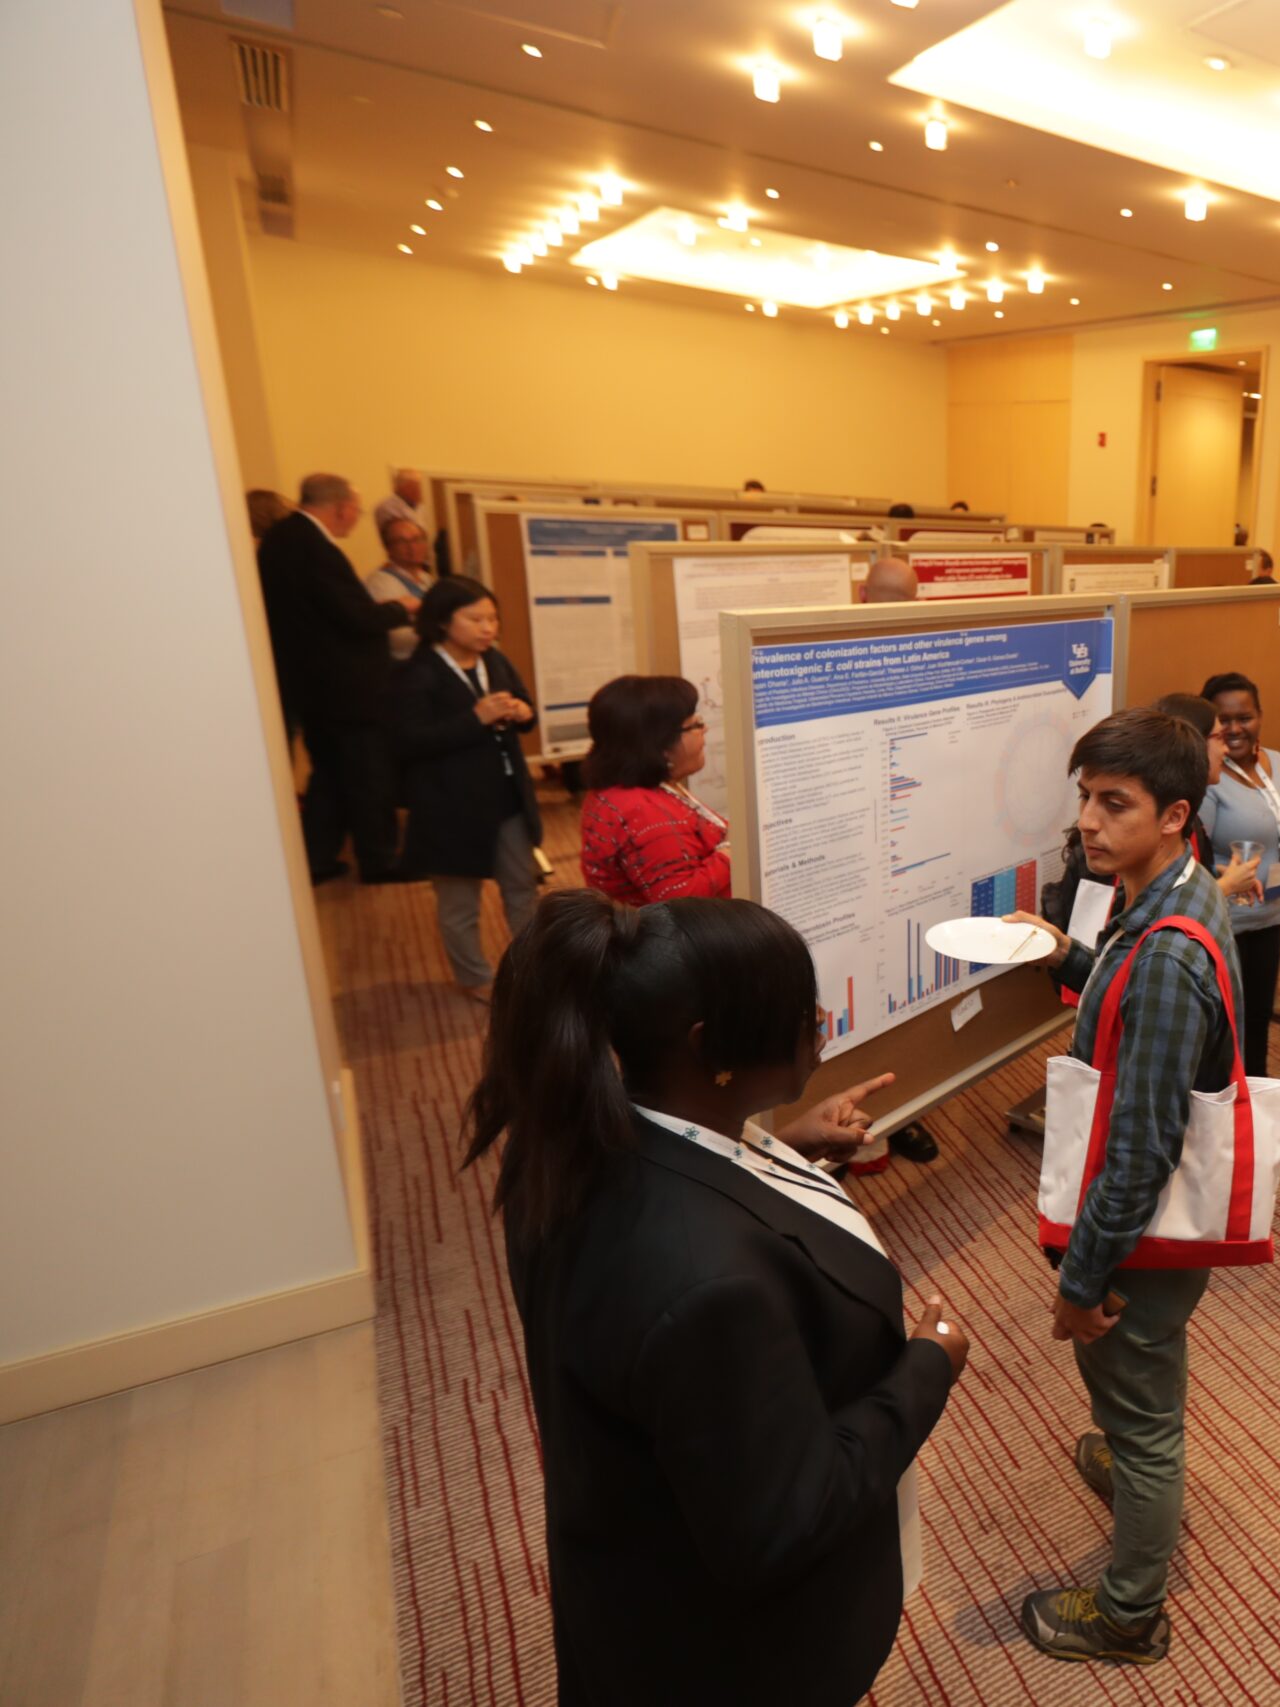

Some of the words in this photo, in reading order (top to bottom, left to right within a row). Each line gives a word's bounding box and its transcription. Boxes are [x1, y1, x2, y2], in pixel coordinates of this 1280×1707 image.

[803, 649, 814, 660] of
[816, 644, 868, 659] colonization
[869, 642, 897, 654] factors
[899, 641, 913, 651] and
[914, 638, 934, 650] other
[825, 662, 834, 672] E.
[836, 661, 852, 671] coli
[854, 657, 882, 670] strains
[883, 655, 901, 667] from
[903, 652, 921, 664] Latin
[922, 650, 950, 662] America
